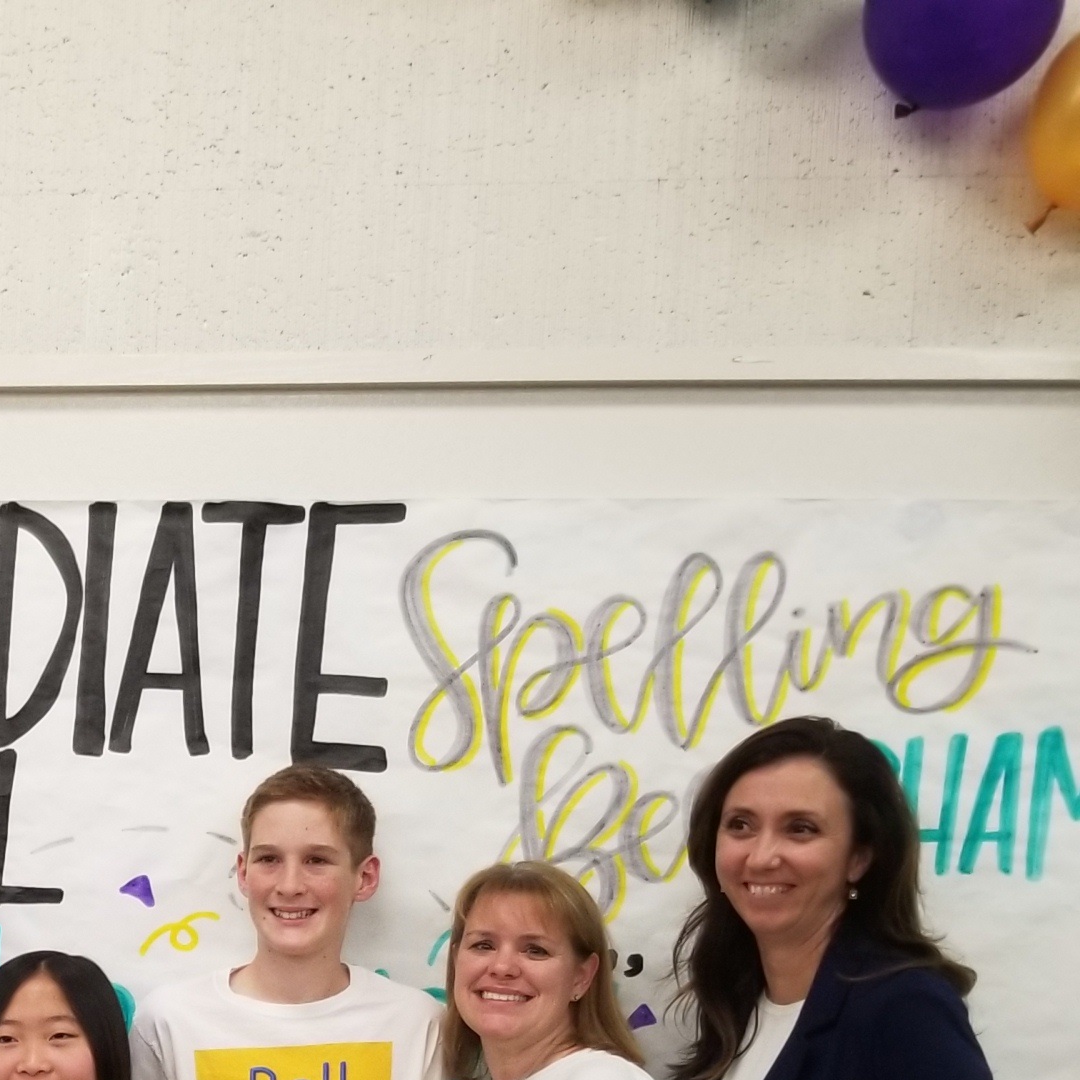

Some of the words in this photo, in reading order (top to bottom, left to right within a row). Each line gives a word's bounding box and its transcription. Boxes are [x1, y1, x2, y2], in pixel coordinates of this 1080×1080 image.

[398, 529, 1039, 787] Spelling
[498, 723, 717, 926] Be
[870, 724, 1080, 882] HAM
